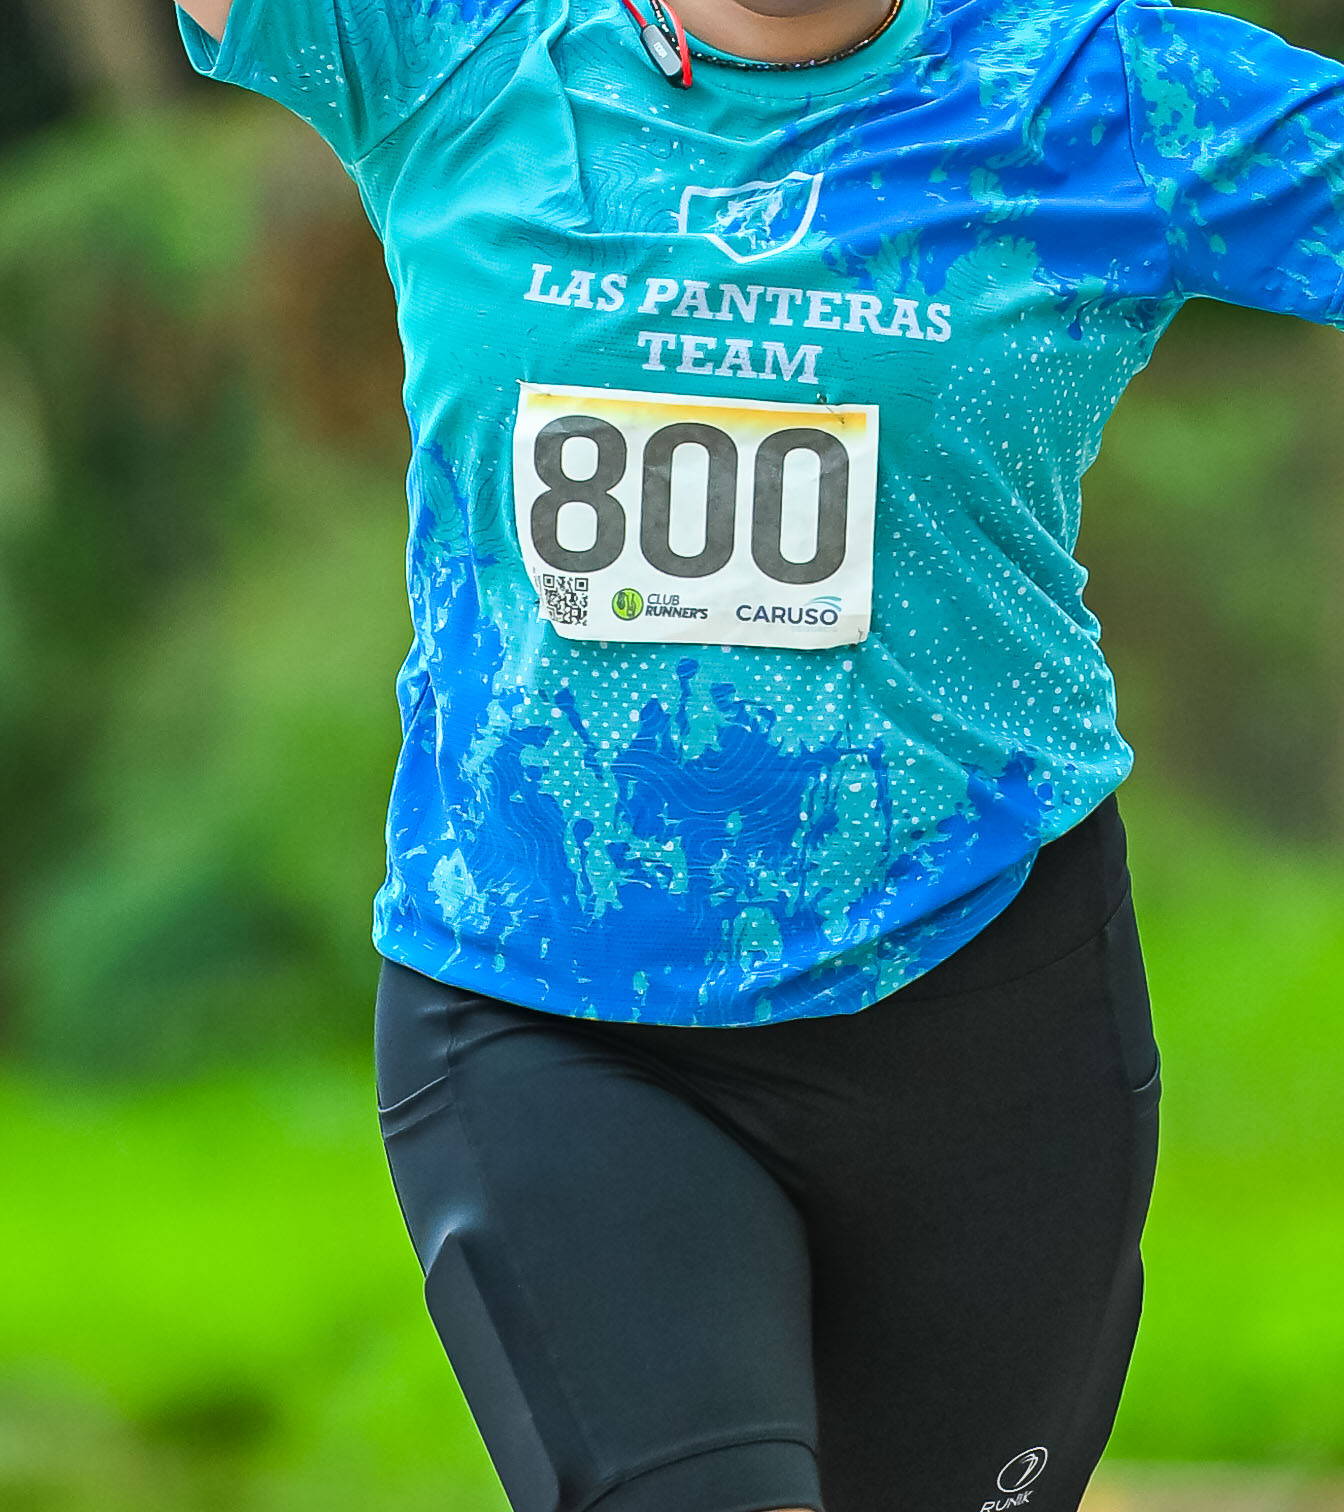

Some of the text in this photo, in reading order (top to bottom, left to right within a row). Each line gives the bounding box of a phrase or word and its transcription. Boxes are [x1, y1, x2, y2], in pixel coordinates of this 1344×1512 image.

[524, 263, 952, 343] LAS PANTERAS
[637, 331, 823, 384] TEAM
[531, 415, 850, 585] 800
[645, 606, 709, 620] RUNNER'S
[647, 594, 680, 606] CLUB
[736, 604, 838, 626] CARUSO
